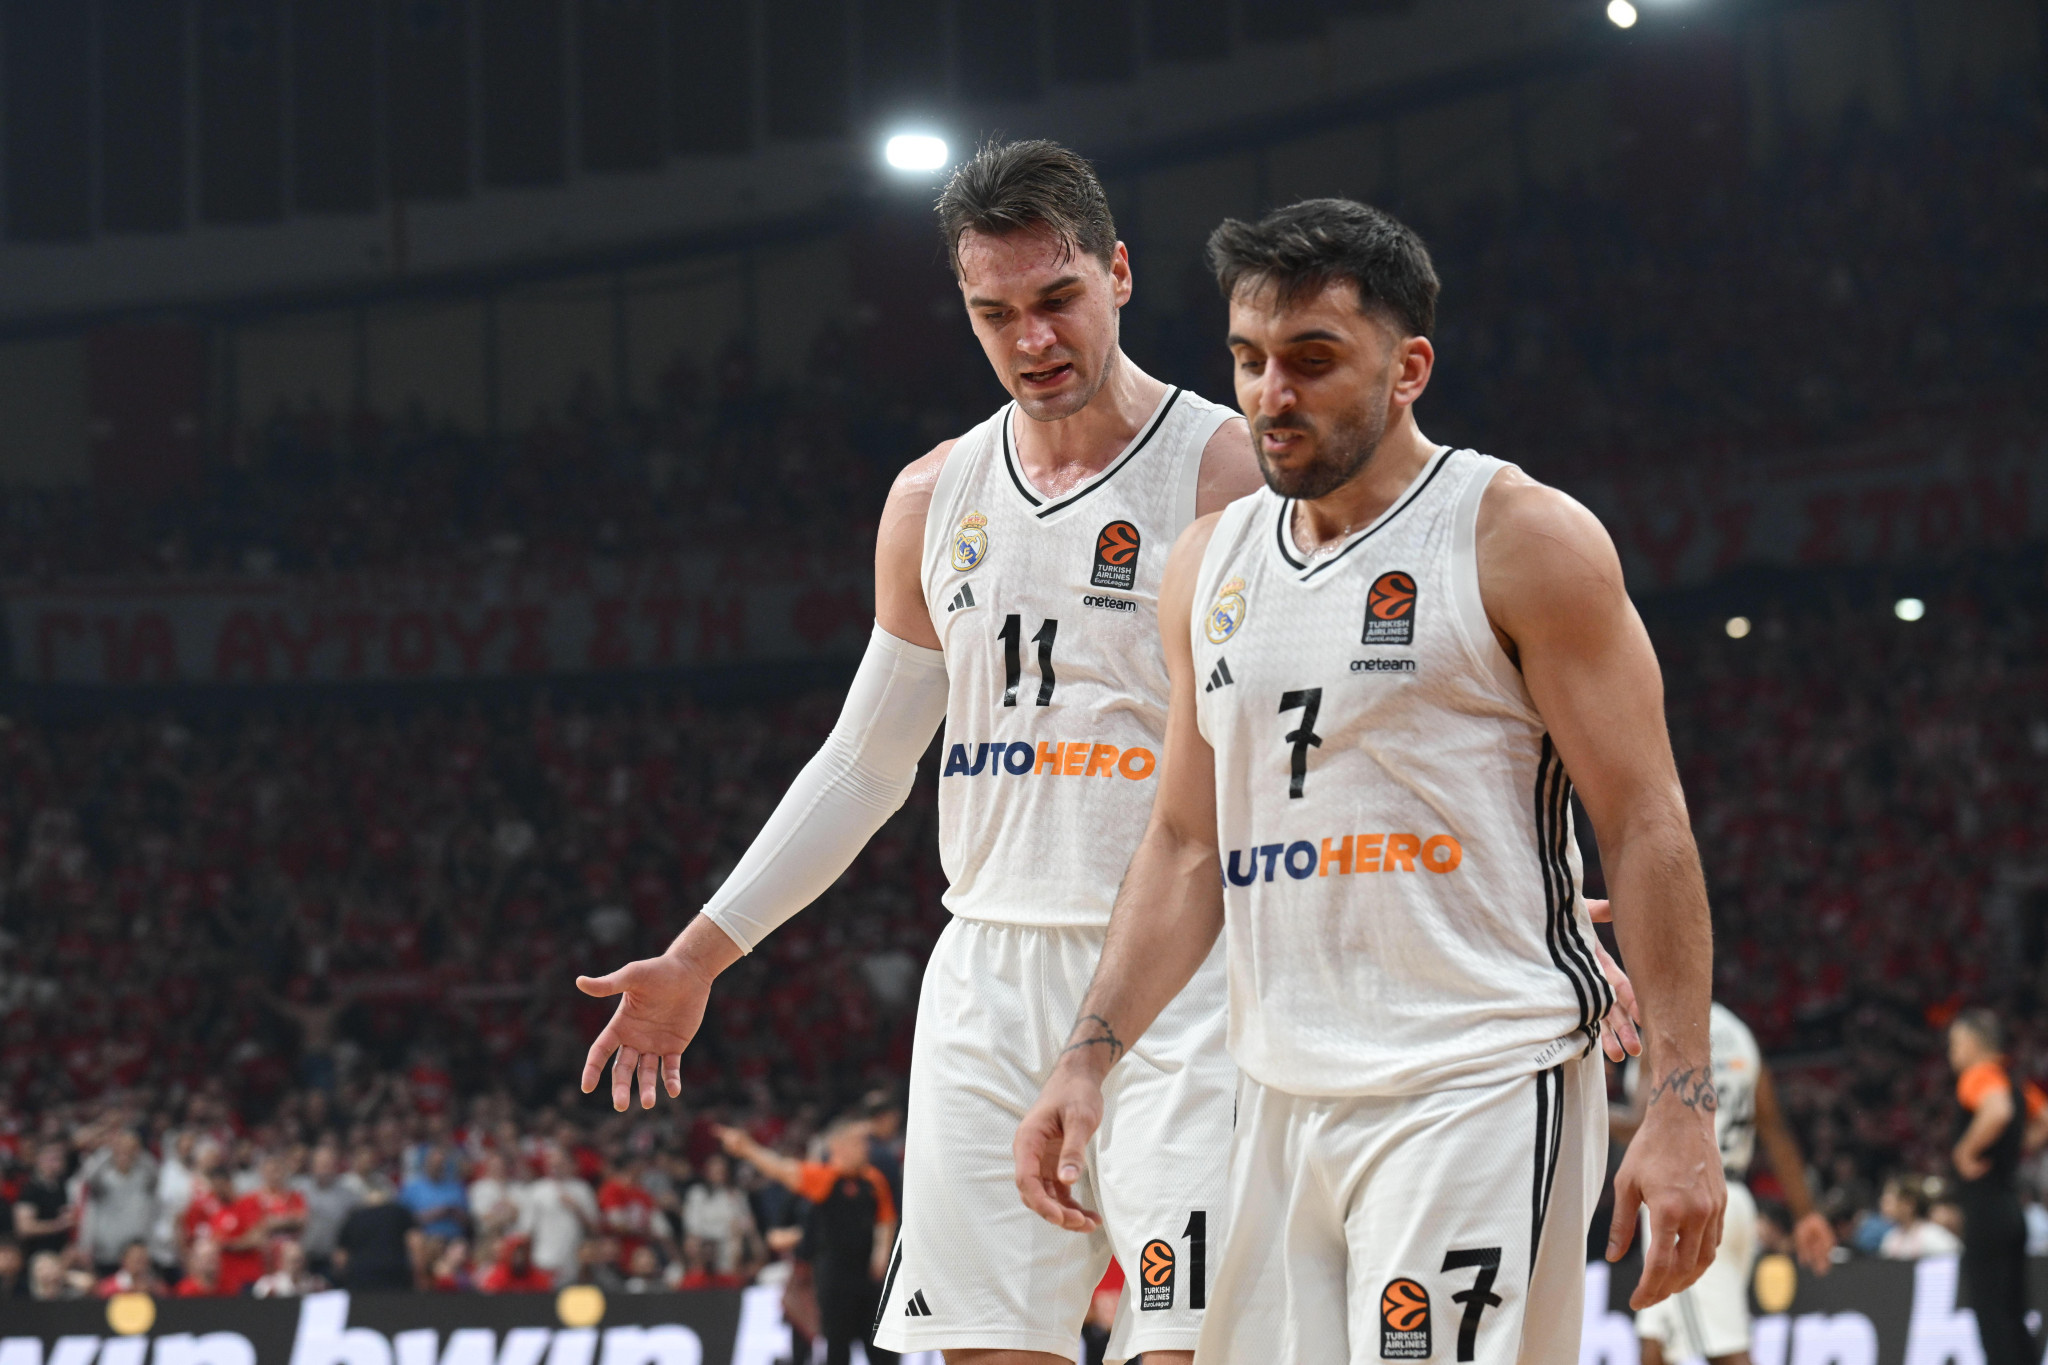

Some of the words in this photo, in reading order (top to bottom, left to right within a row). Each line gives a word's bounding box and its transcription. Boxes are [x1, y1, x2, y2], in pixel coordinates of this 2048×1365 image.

[1608, 500, 1755, 588] ΥΣ
[1098, 564, 1132, 574] TURKISH
[1096, 571, 1131, 581] AIRLINES
[1094, 577, 1130, 587] EuroLeague
[1083, 595, 1136, 612] oneteam
[1368, 620, 1409, 629] TURKISH
[1367, 628, 1408, 636] AIRLINES
[997, 614, 1058, 707] 11
[1350, 658, 1416, 671] oneteam
[1278, 687, 1323, 799] 7
[943, 741, 1156, 781] AUTOHERO
[1221, 833, 1463, 888] UTOHERO
[1144, 1286, 1170, 1294] TURKISH
[1440, 1247, 1503, 1362] 7
[1385, 1332, 1426, 1340] TURKISH
[1385, 1341, 1427, 1349] AIRLINES
